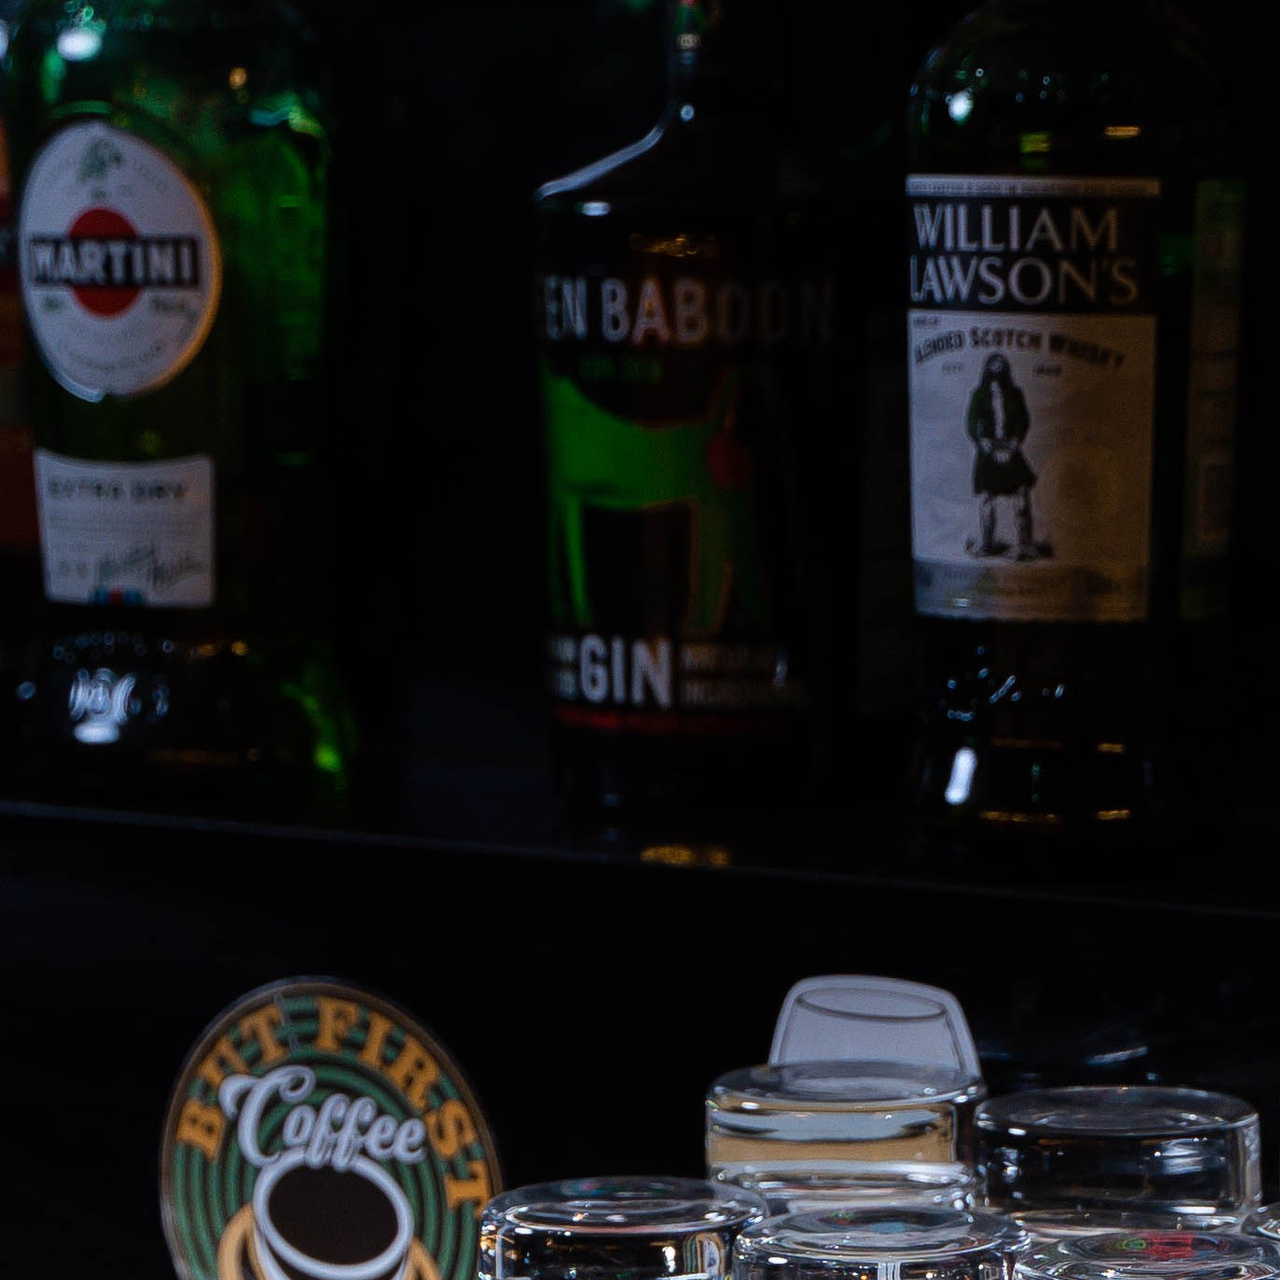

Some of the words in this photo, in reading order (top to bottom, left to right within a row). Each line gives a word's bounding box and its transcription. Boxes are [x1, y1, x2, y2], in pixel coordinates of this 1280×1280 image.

[34, 238, 194, 285] MARTINI
[912, 202, 1121, 252] WILLIAM
[600, 274, 835, 346] BABOON
[909, 253, 1140, 305] LAWSON'S
[578, 632, 673, 708] GIN
[218, 1064, 428, 1173] Coffee
[315, 995, 491, 1219] FIRST
